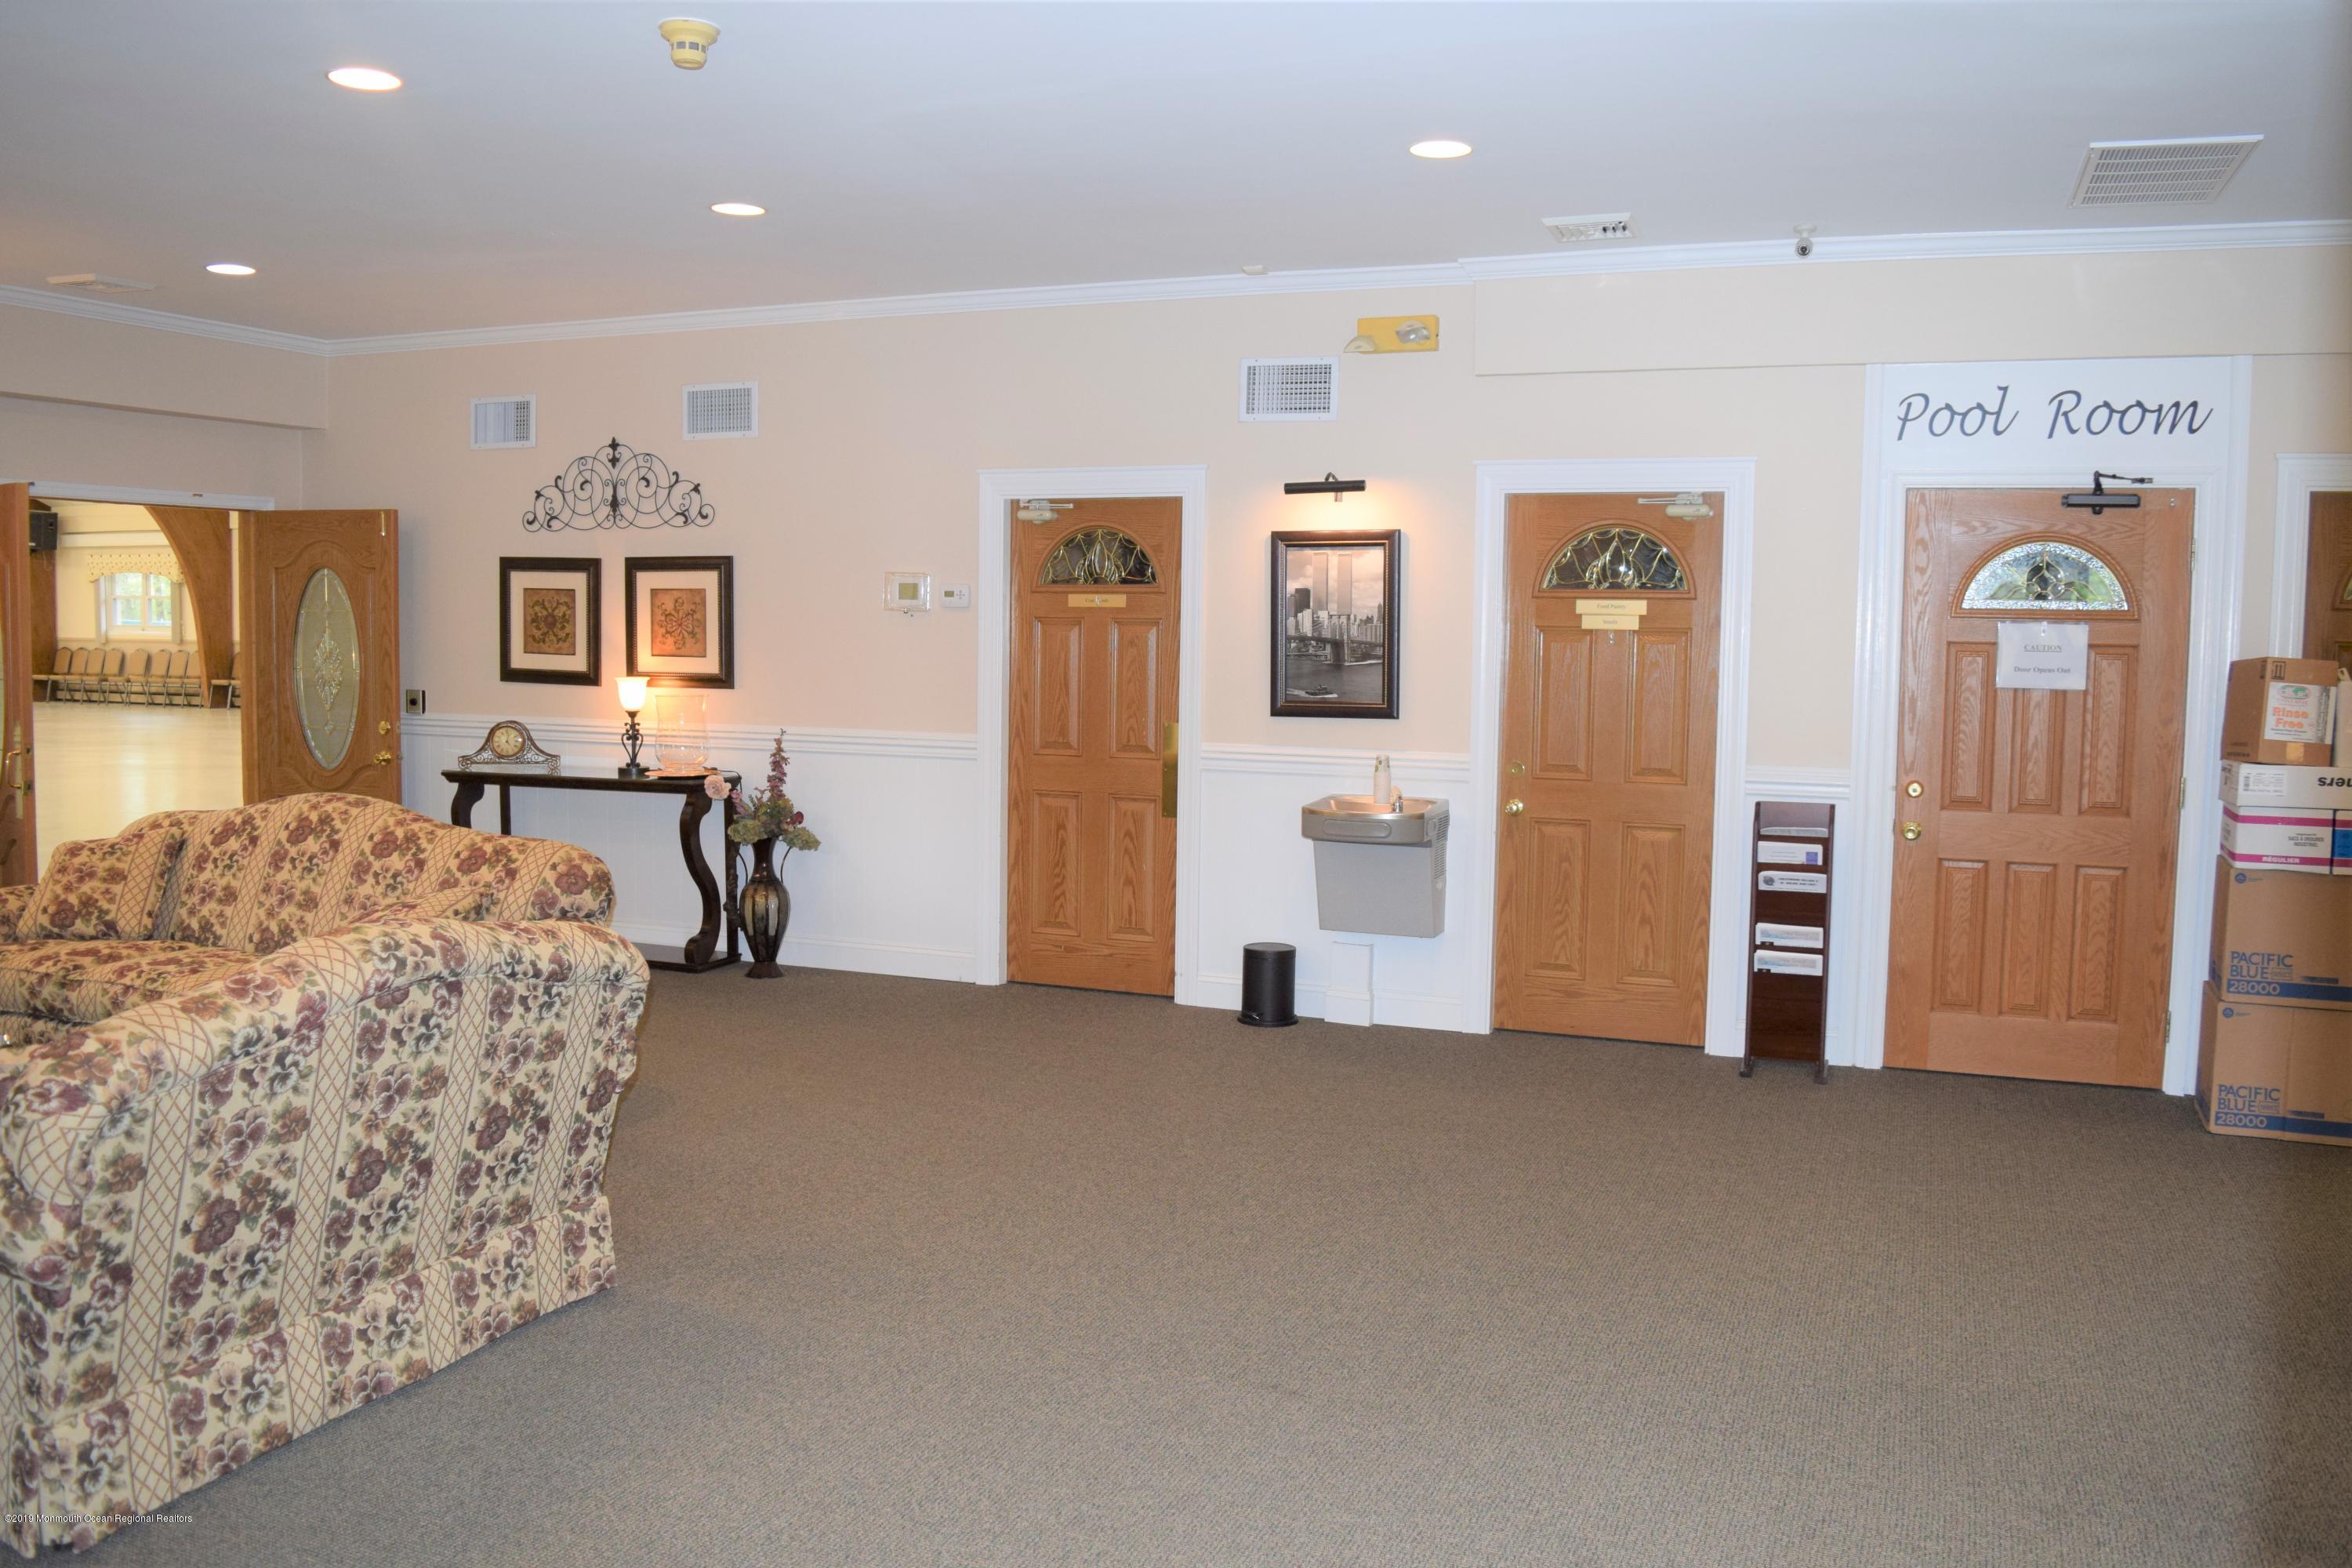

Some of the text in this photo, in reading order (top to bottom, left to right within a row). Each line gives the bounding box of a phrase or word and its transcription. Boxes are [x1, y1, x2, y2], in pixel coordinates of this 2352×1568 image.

[1896, 385, 2214, 441] Pool Room
[2272, 706, 2309, 719] Rinse
[2275, 718, 2304, 728] Free
[2230, 951, 2294, 968] PACIFIC
[2230, 964, 2270, 980] BLUE
[2228, 981, 2281, 996] 28000
[2218, 1084, 2281, 1102] PACIFIC
[2218, 1098, 2257, 1113] BLUE
[2216, 1113, 2268, 1129] 28000
